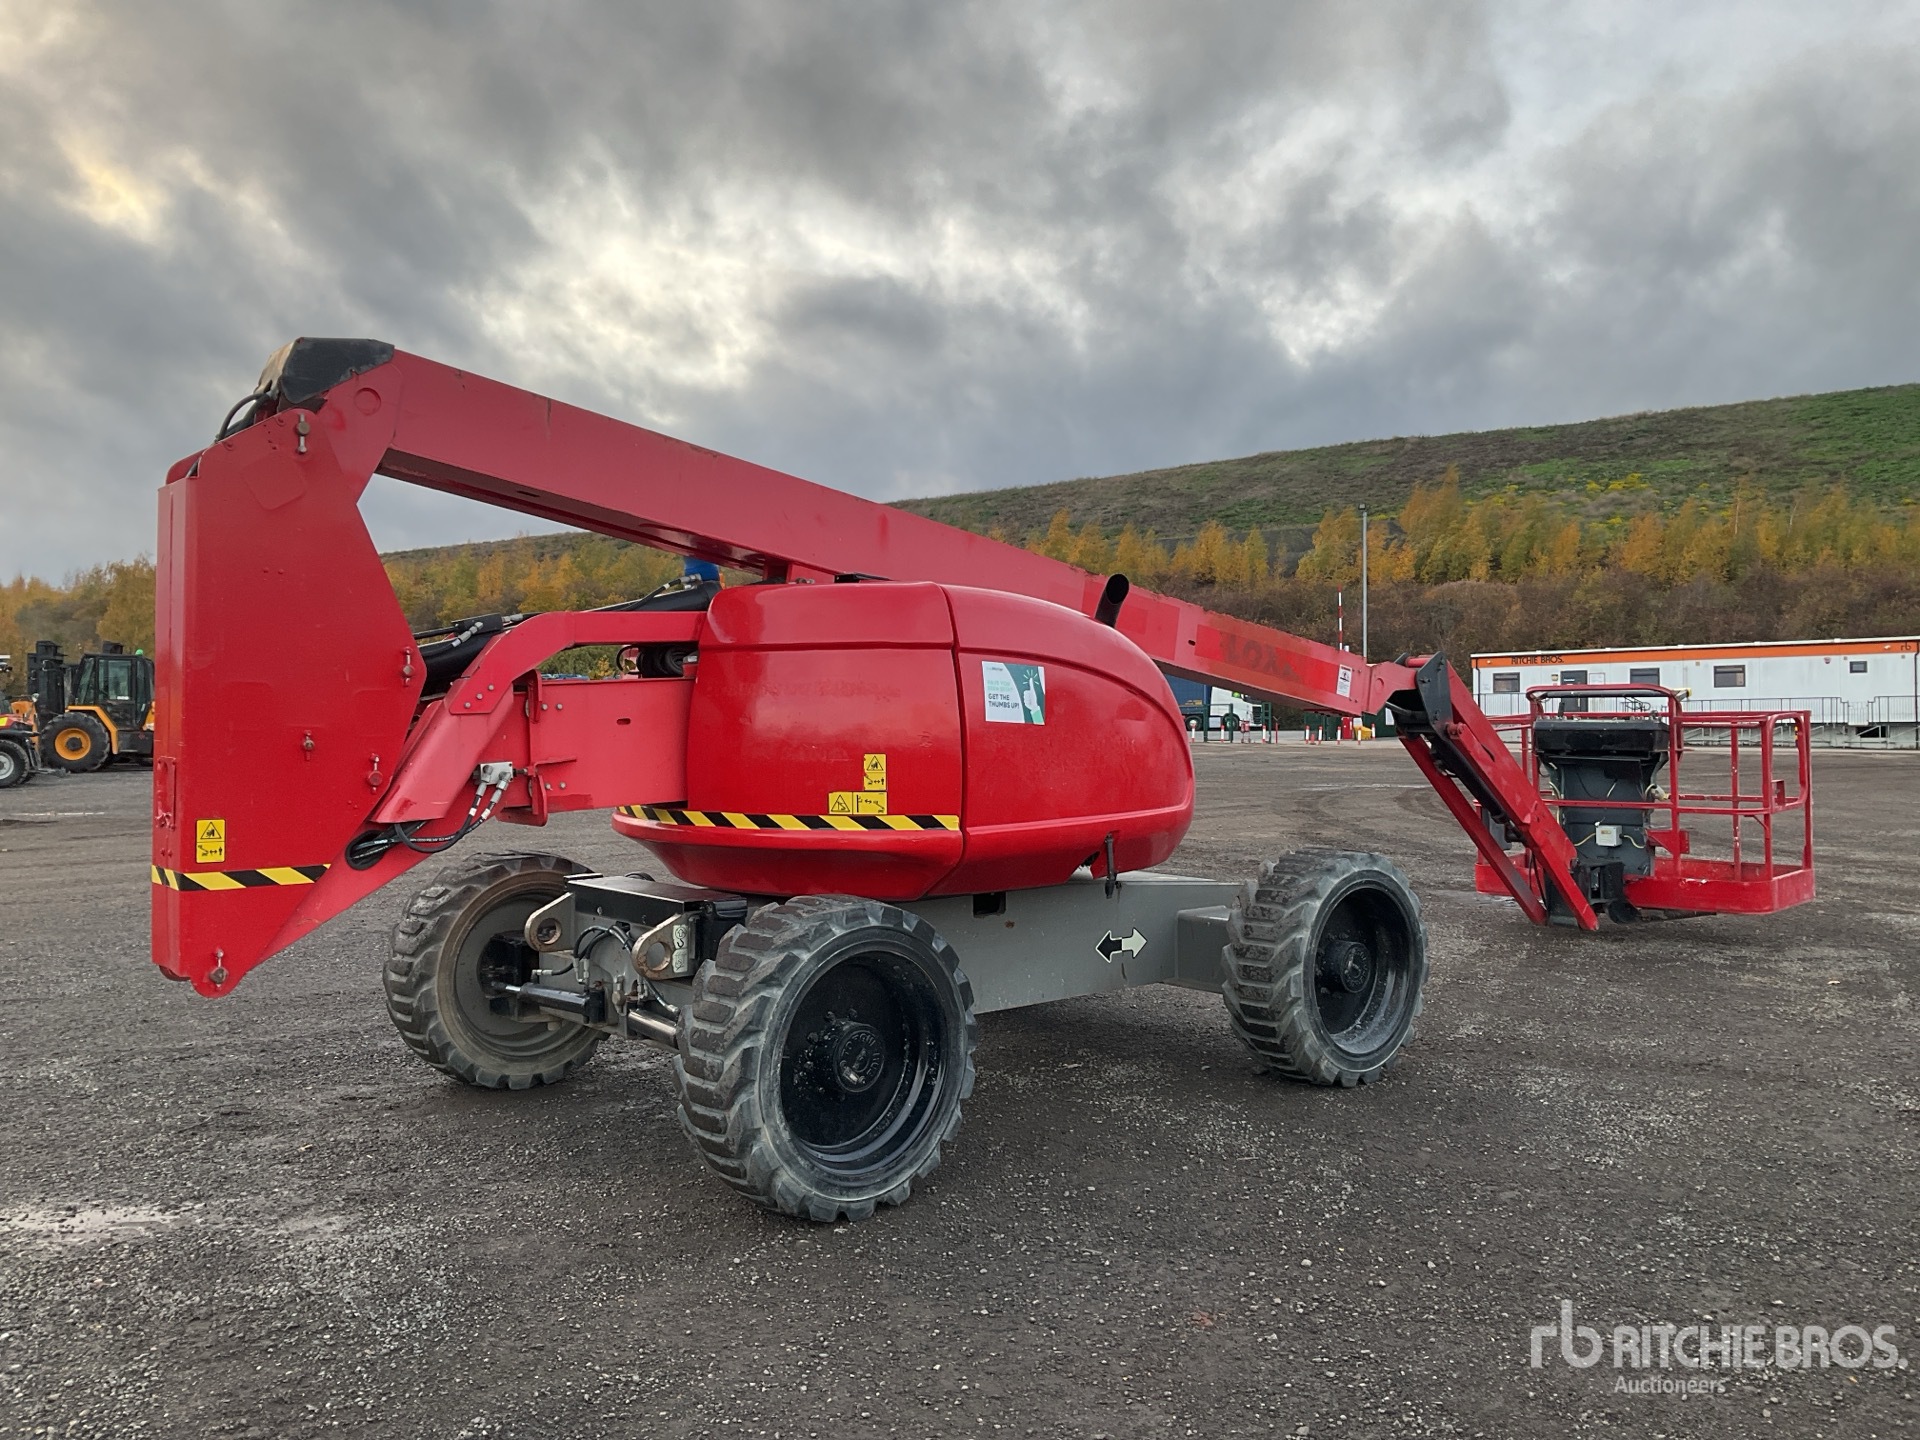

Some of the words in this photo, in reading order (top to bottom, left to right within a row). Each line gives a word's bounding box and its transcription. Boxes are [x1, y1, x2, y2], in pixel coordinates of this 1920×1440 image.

[1511, 656, 1538, 665] RITCHIE
[1540, 655, 1565, 664] BROS.
[988, 701, 1010, 709] THUMBS
[1010, 702, 1020, 710] UP!
